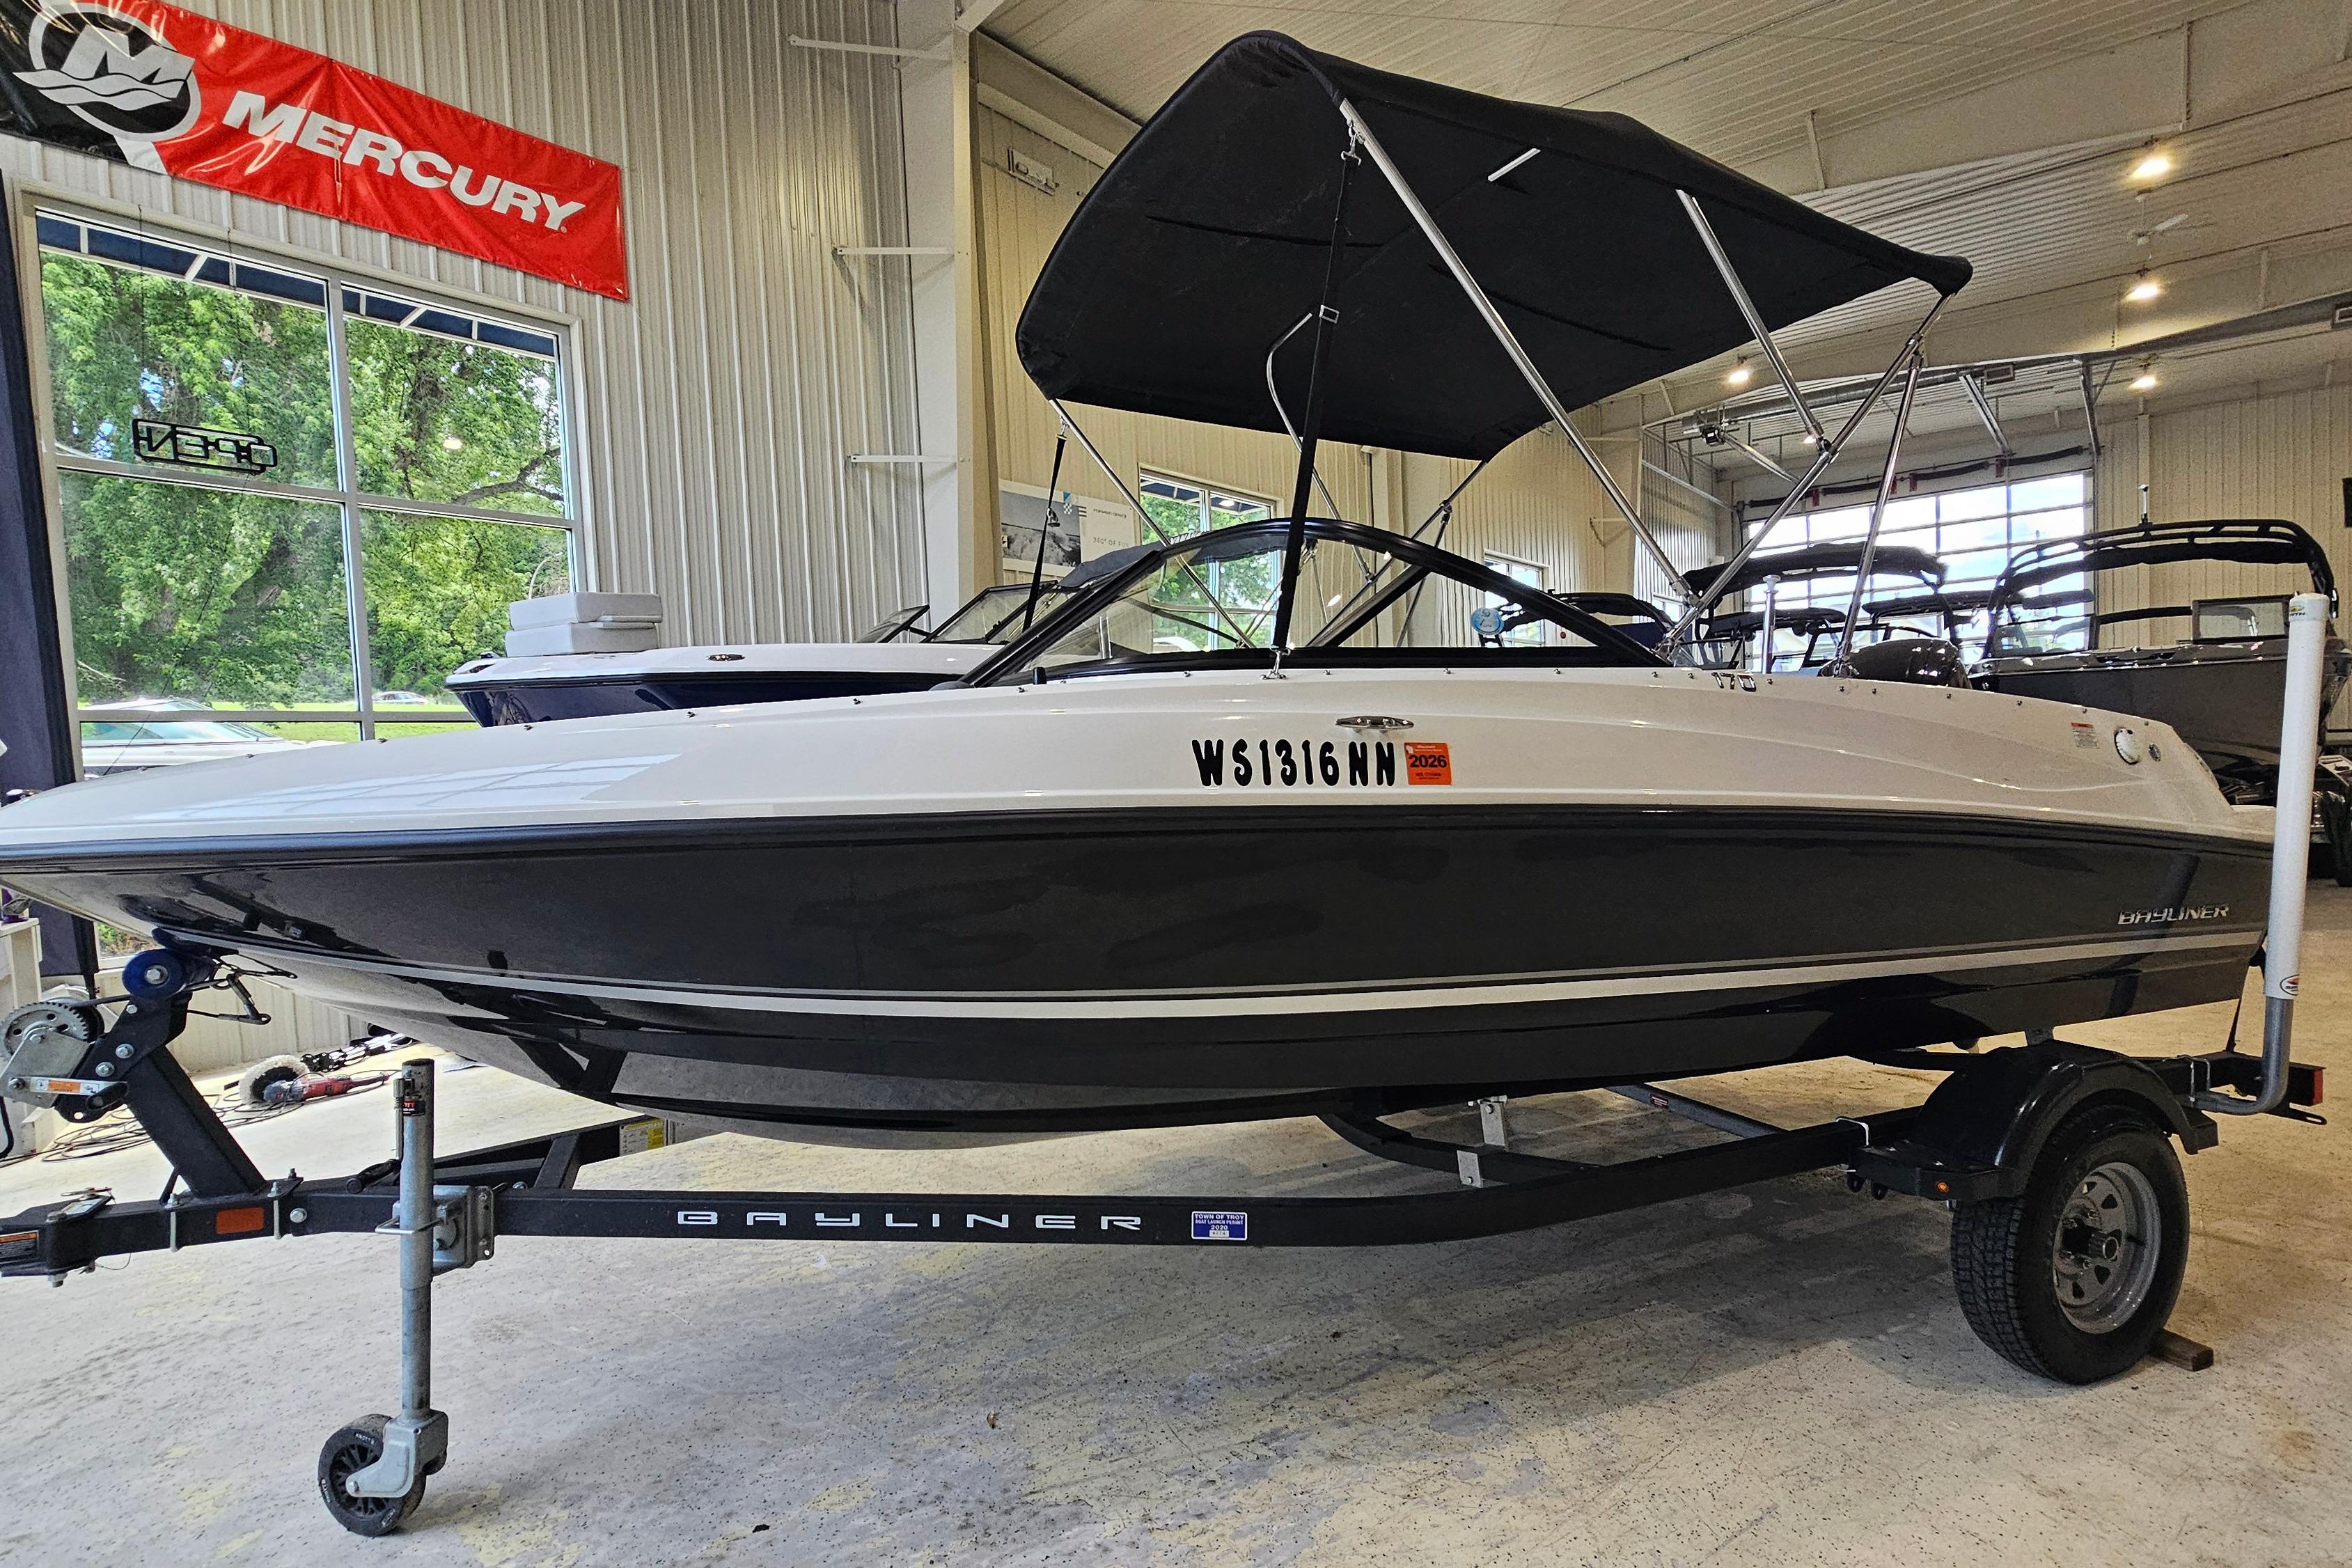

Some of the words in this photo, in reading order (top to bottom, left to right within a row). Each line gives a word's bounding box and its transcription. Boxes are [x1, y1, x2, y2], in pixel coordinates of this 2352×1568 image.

[222, 91, 586, 230] MERCURY
[1711, 672, 1757, 692] 170
[1191, 738, 1395, 787] WS1316NN
[1409, 755, 1447, 768] 2026
[2117, 904, 2229, 925] BAYLINER
[677, 1212, 1141, 1230] BAYLINER
